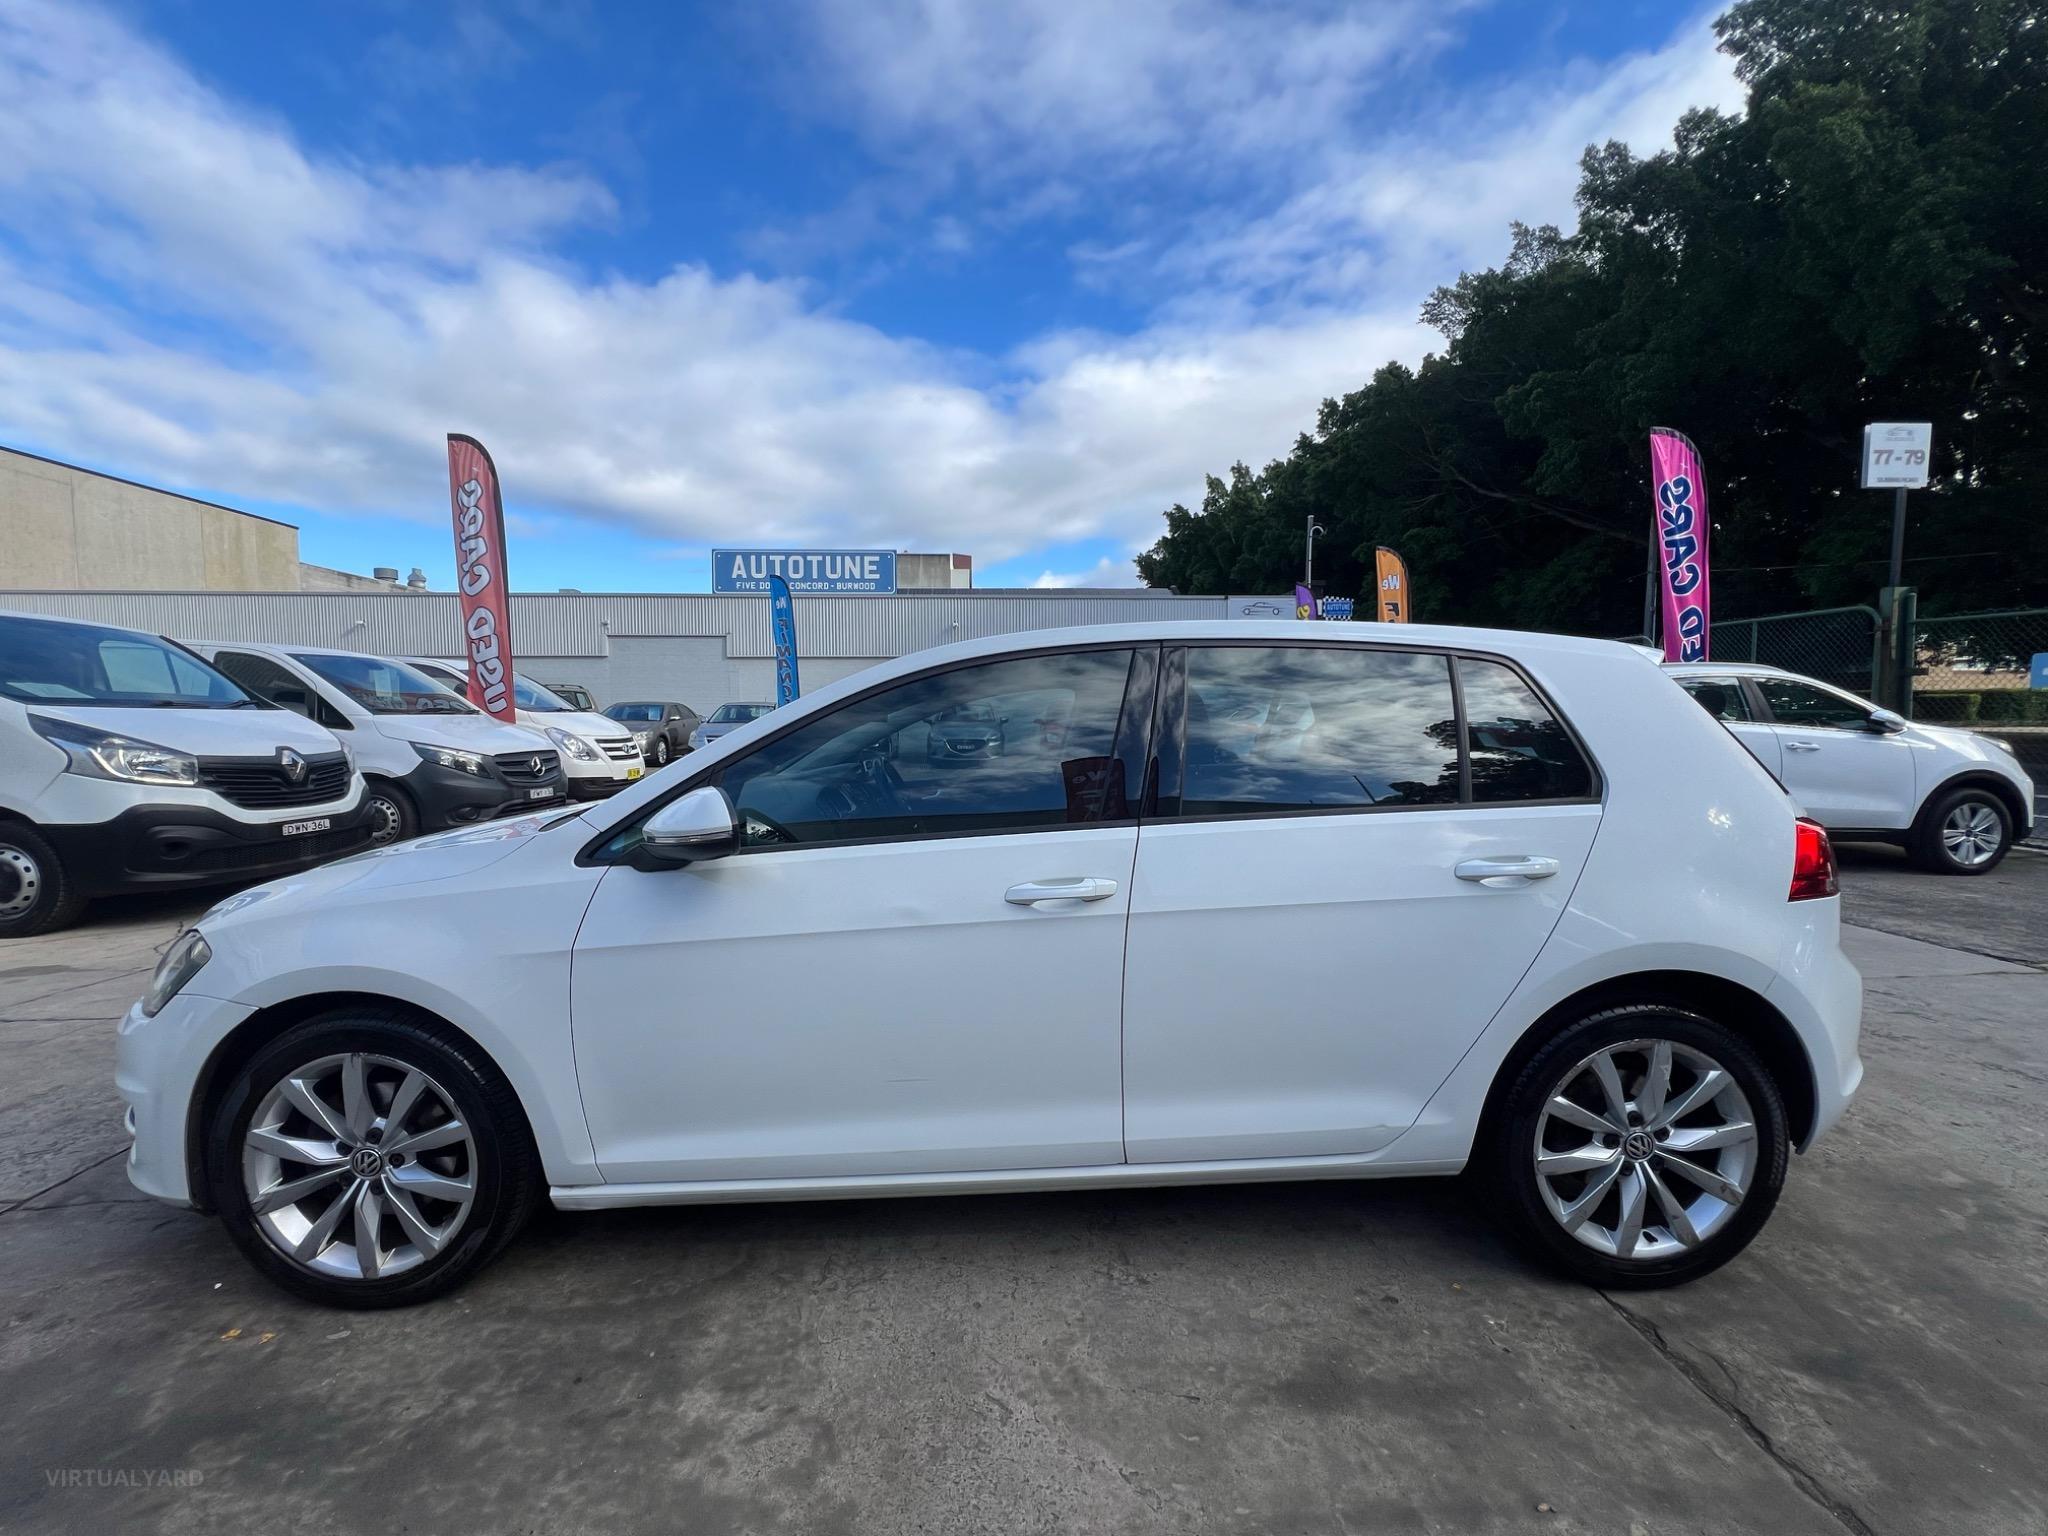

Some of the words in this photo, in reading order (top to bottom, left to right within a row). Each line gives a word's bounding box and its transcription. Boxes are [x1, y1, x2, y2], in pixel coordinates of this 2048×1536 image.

[731, 555, 880, 579] AUTOTUNE
[735, 581, 756, 590] FIVE
[790, 582, 829, 590] CONCORD
[836, 582, 876, 590] BURWOOD
